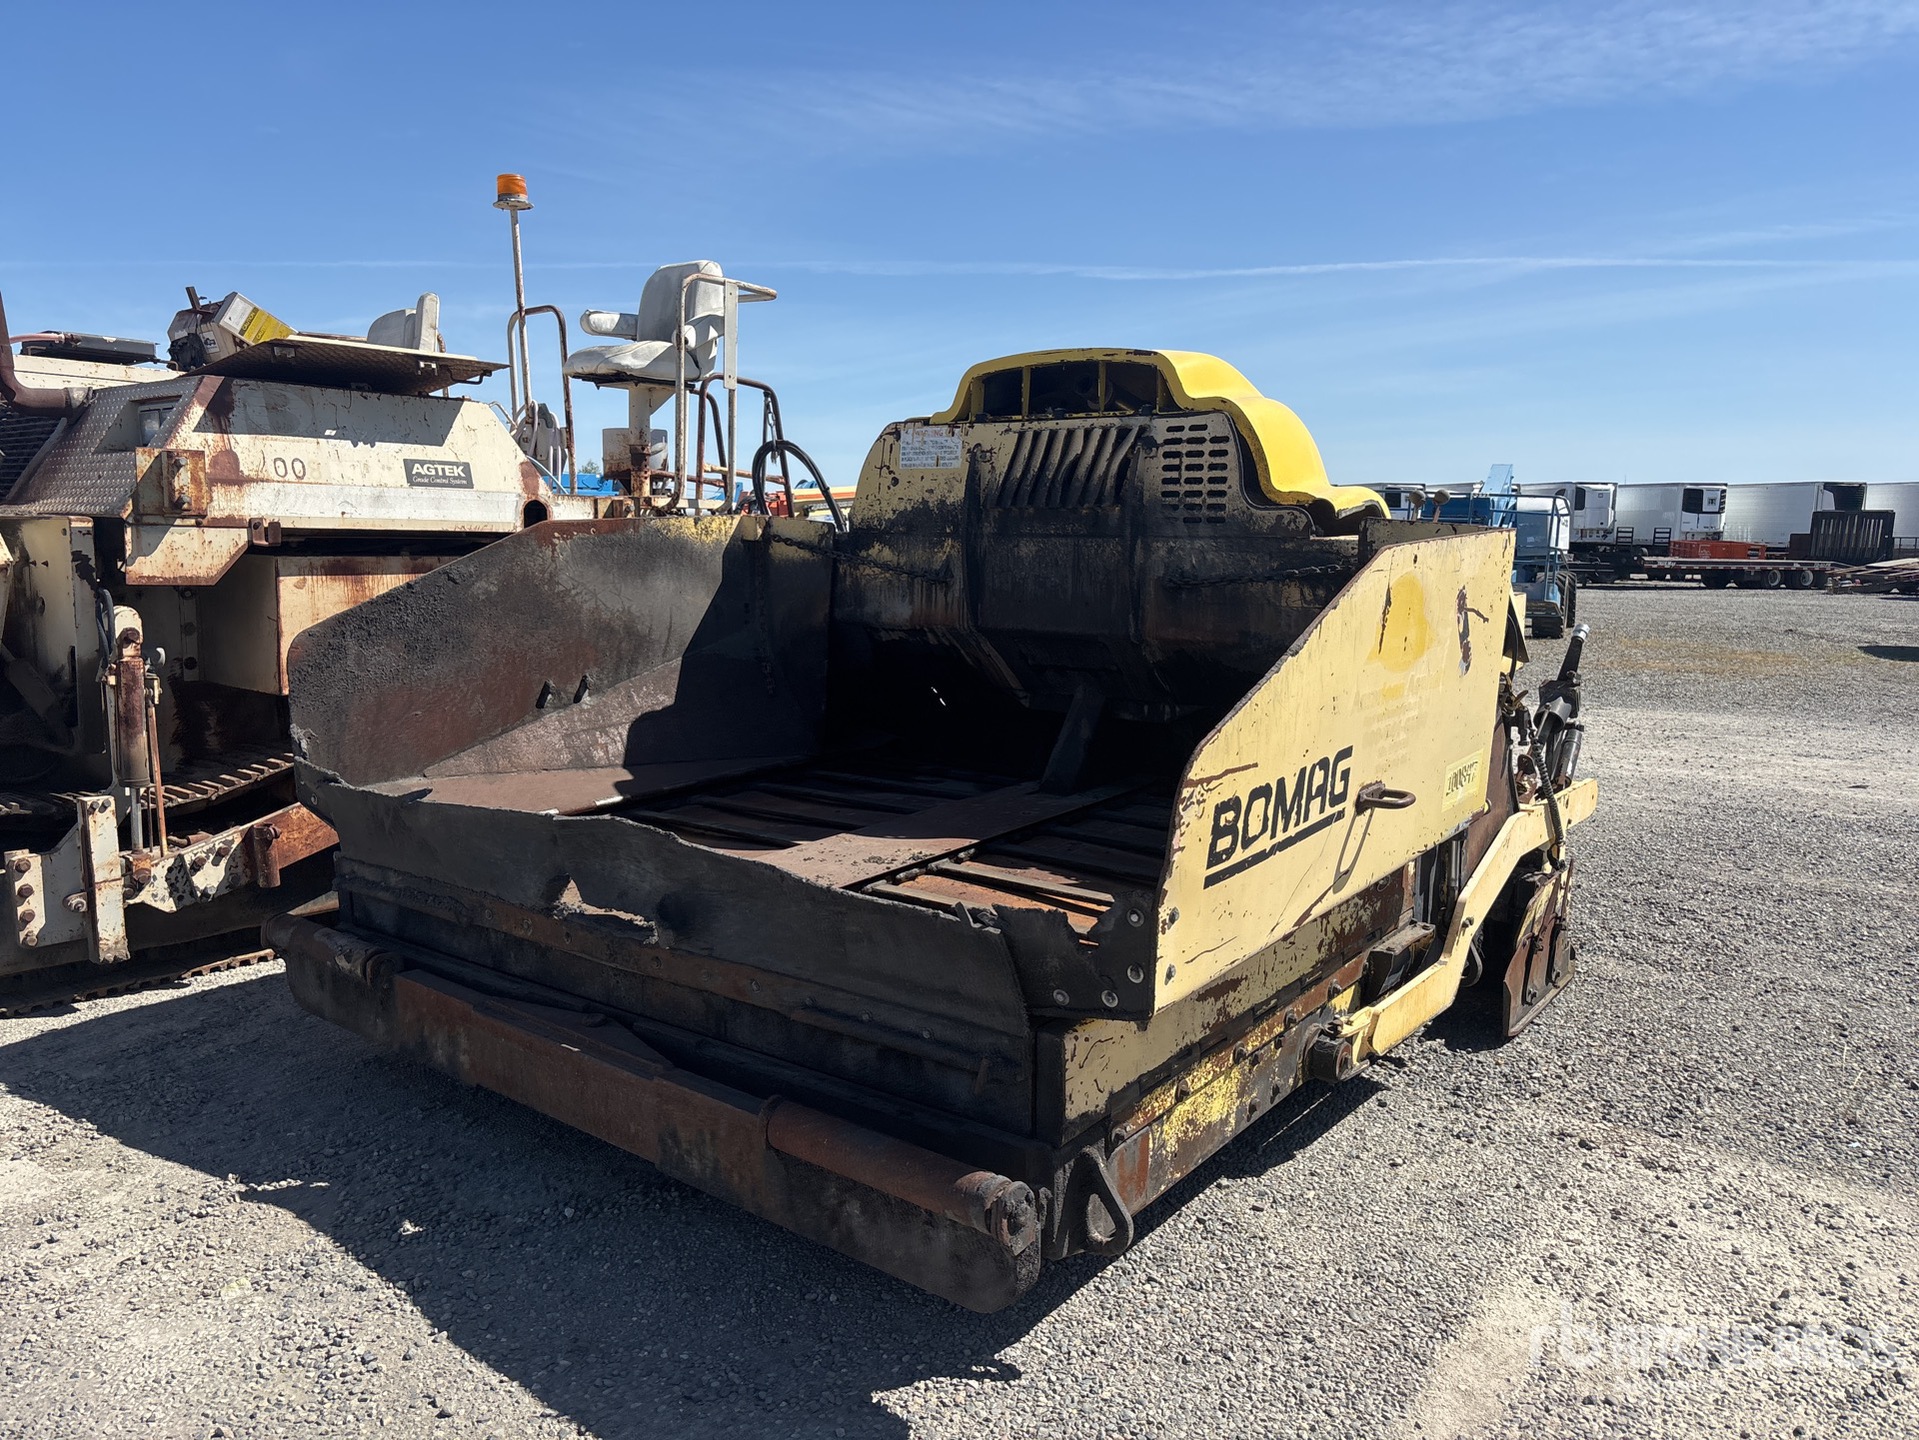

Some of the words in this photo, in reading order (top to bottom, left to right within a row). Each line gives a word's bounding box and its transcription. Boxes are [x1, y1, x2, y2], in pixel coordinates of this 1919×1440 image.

[242, 311, 257, 331] CAUTION
[411, 463, 467, 477] AGTEK
[412, 475, 429, 484] Grade
[430, 476, 449, 485] Control
[449, 477, 468, 486] System
[1206, 745, 1353, 870] BOMAG
